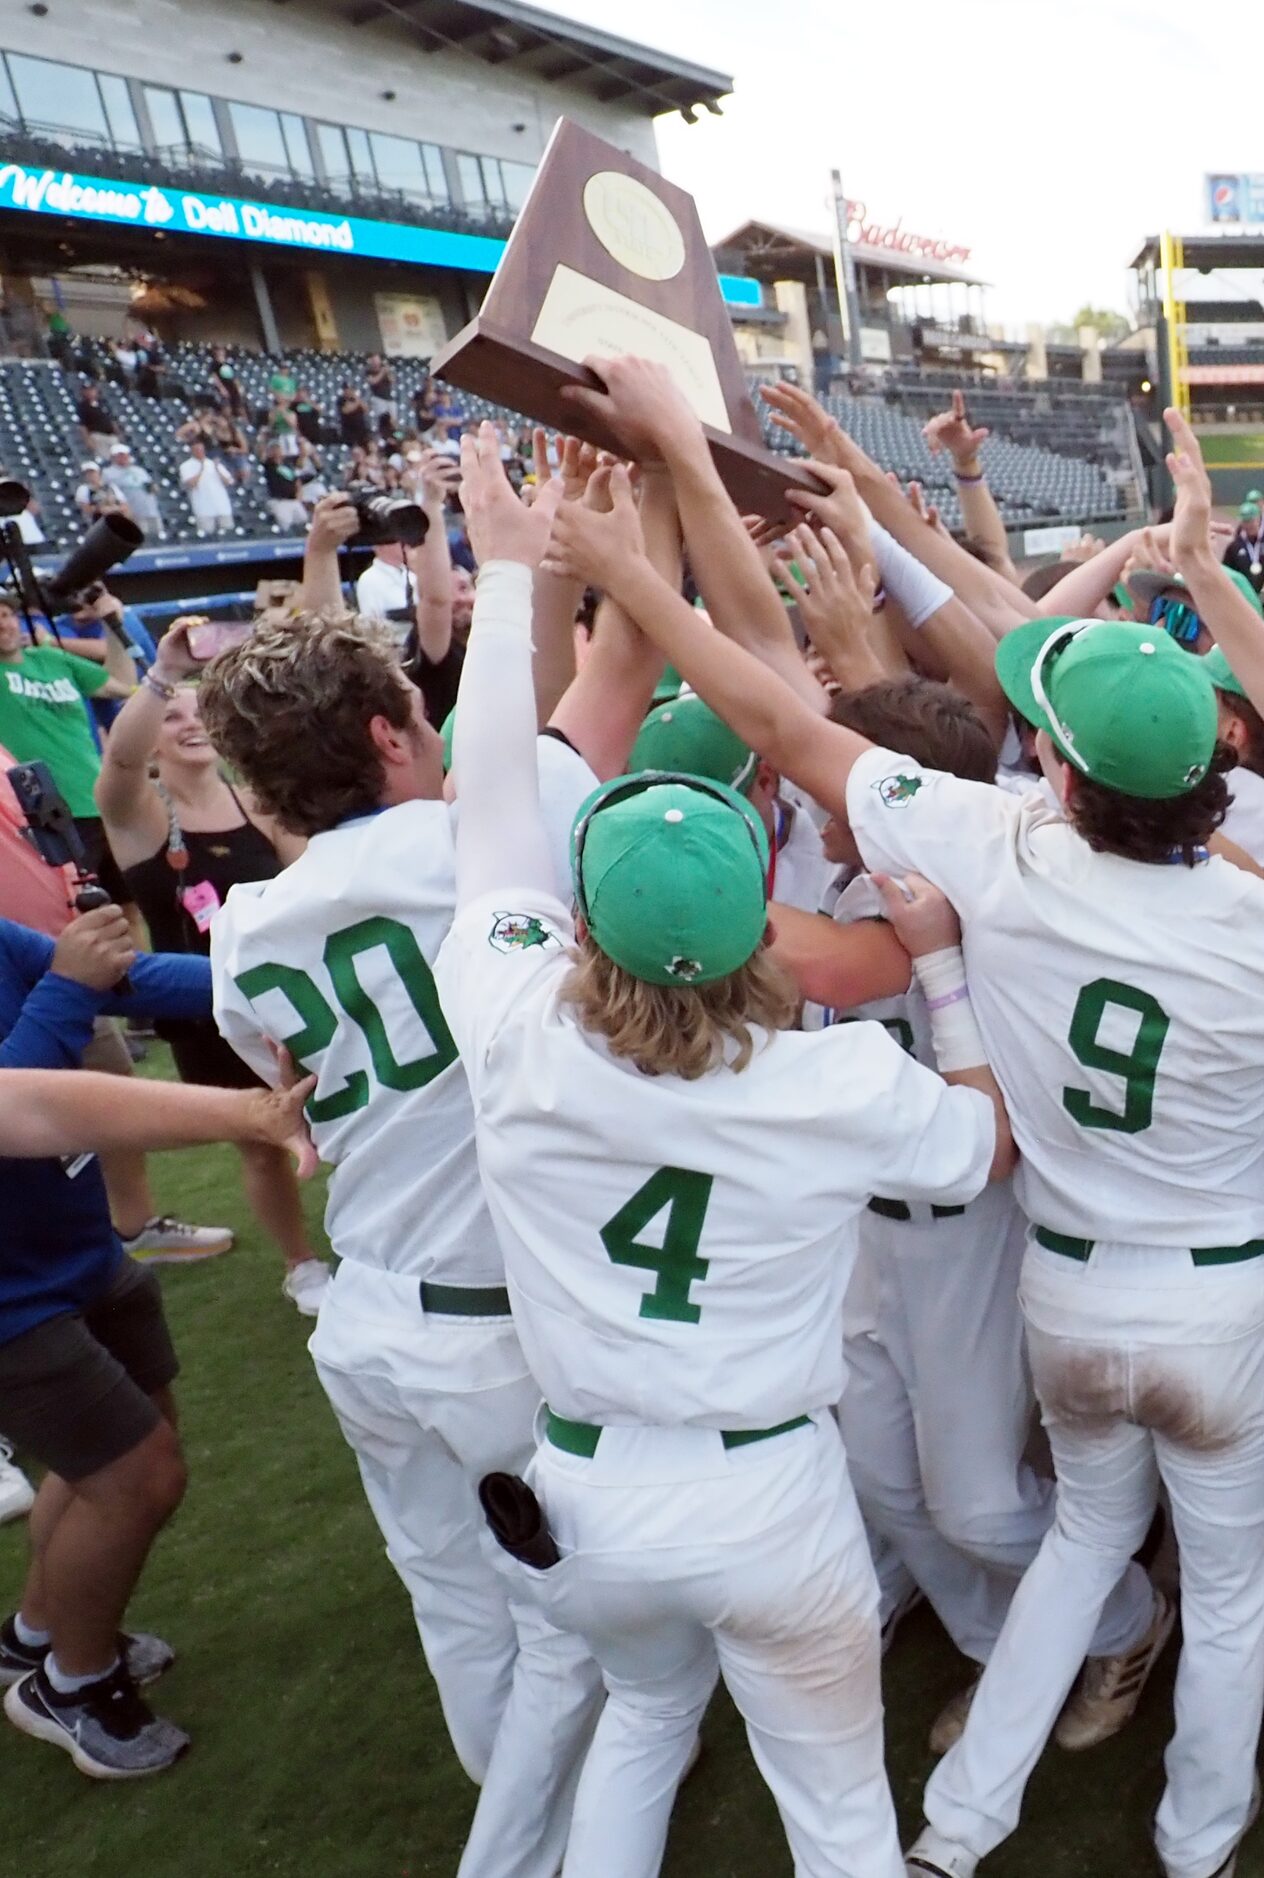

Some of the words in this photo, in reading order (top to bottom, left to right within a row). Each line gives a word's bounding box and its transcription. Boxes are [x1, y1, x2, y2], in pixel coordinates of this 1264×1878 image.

[0, 165, 142, 211] Welcome
[140, 187, 174, 223] to
[182, 195, 239, 234] Dell
[241, 203, 354, 249] Diamond
[233, 915, 461, 1124] 20
[1062, 977, 1171, 1135] 9
[598, 1165, 714, 1325] 4
